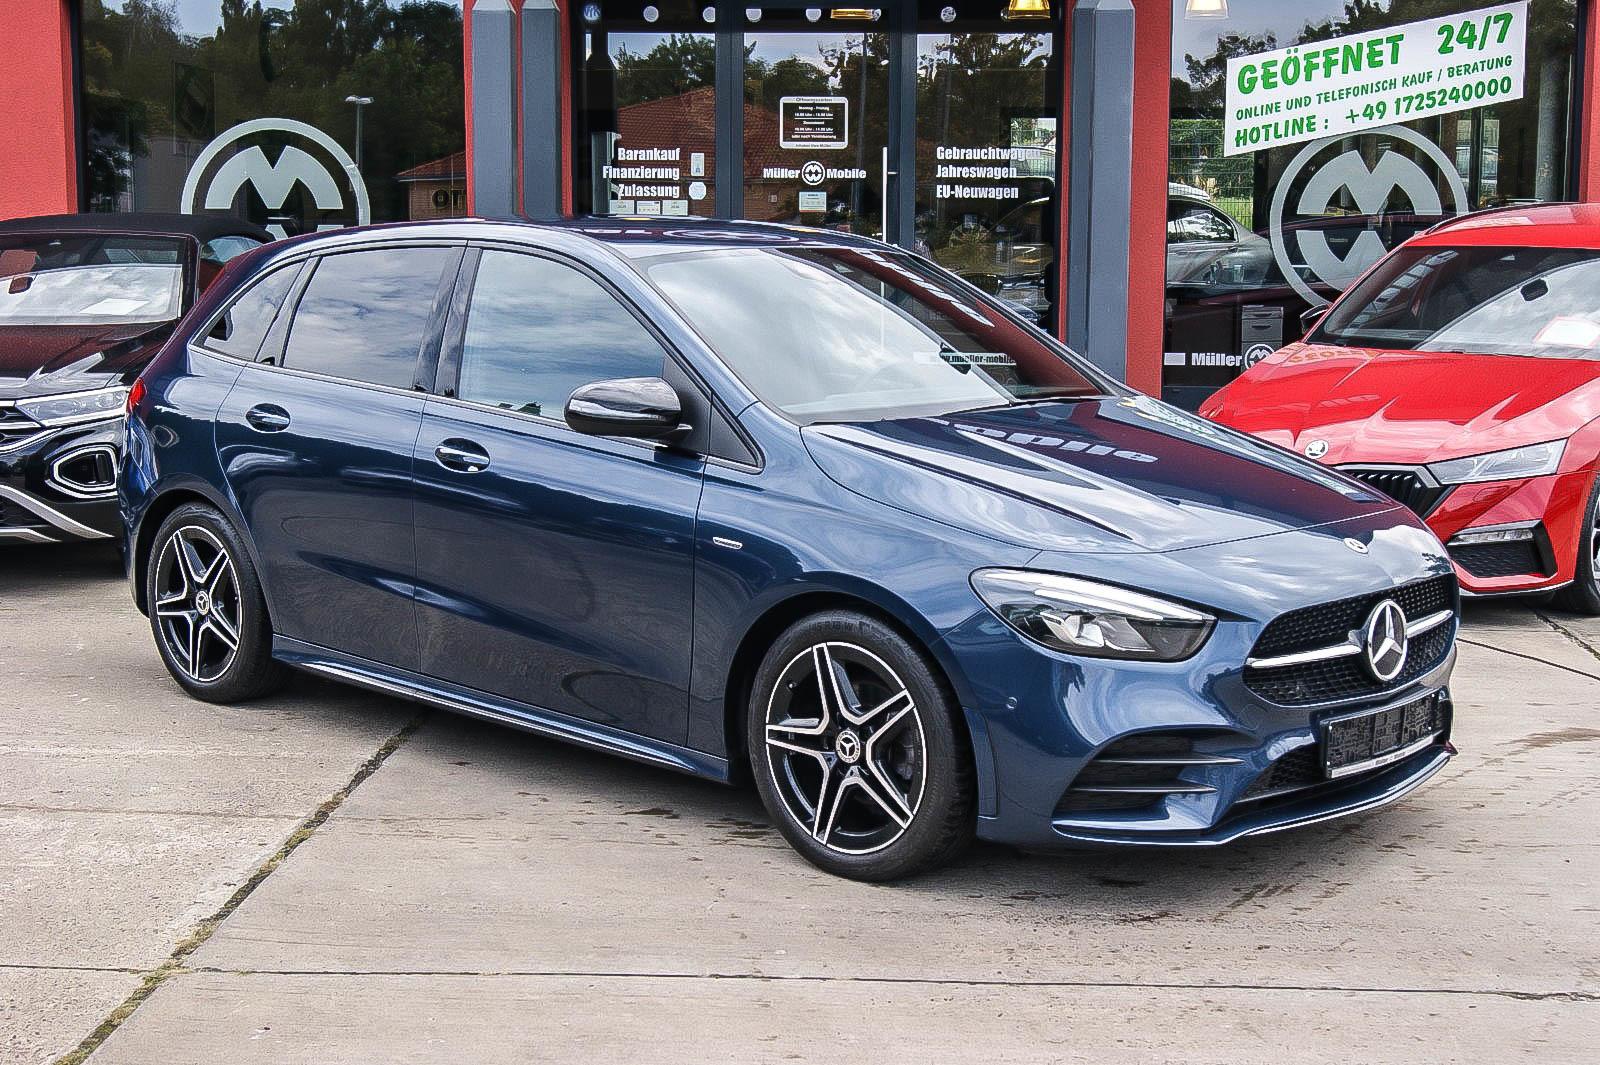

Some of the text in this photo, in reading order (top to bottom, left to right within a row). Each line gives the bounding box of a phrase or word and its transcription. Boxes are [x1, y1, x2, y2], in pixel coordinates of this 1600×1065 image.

[1237, 13, 1514, 95] GEÖFFNET 24/7
[1235, 54, 1513, 121] ONLINE UND TELEFONISCH KAUF / BERATUNG
[1234, 114, 1318, 148] HOTLINE
[1345, 100, 1387, 124] +49
[1394, 75, 1512, 116] 1725240000
[617, 147, 681, 161] Barankauf
[936, 146, 1041, 161] Gebrauchtwagen
[602, 165, 681, 180] Finanzierung
[762, 167, 867, 179] Müller Mobile
[935, 164, 1018, 180] Jahreswagen
[618, 183, 681, 199] Zulassung
[936, 184, 1019, 200] EU-Neuwagen
[1191, 352, 1243, 367] Müller
